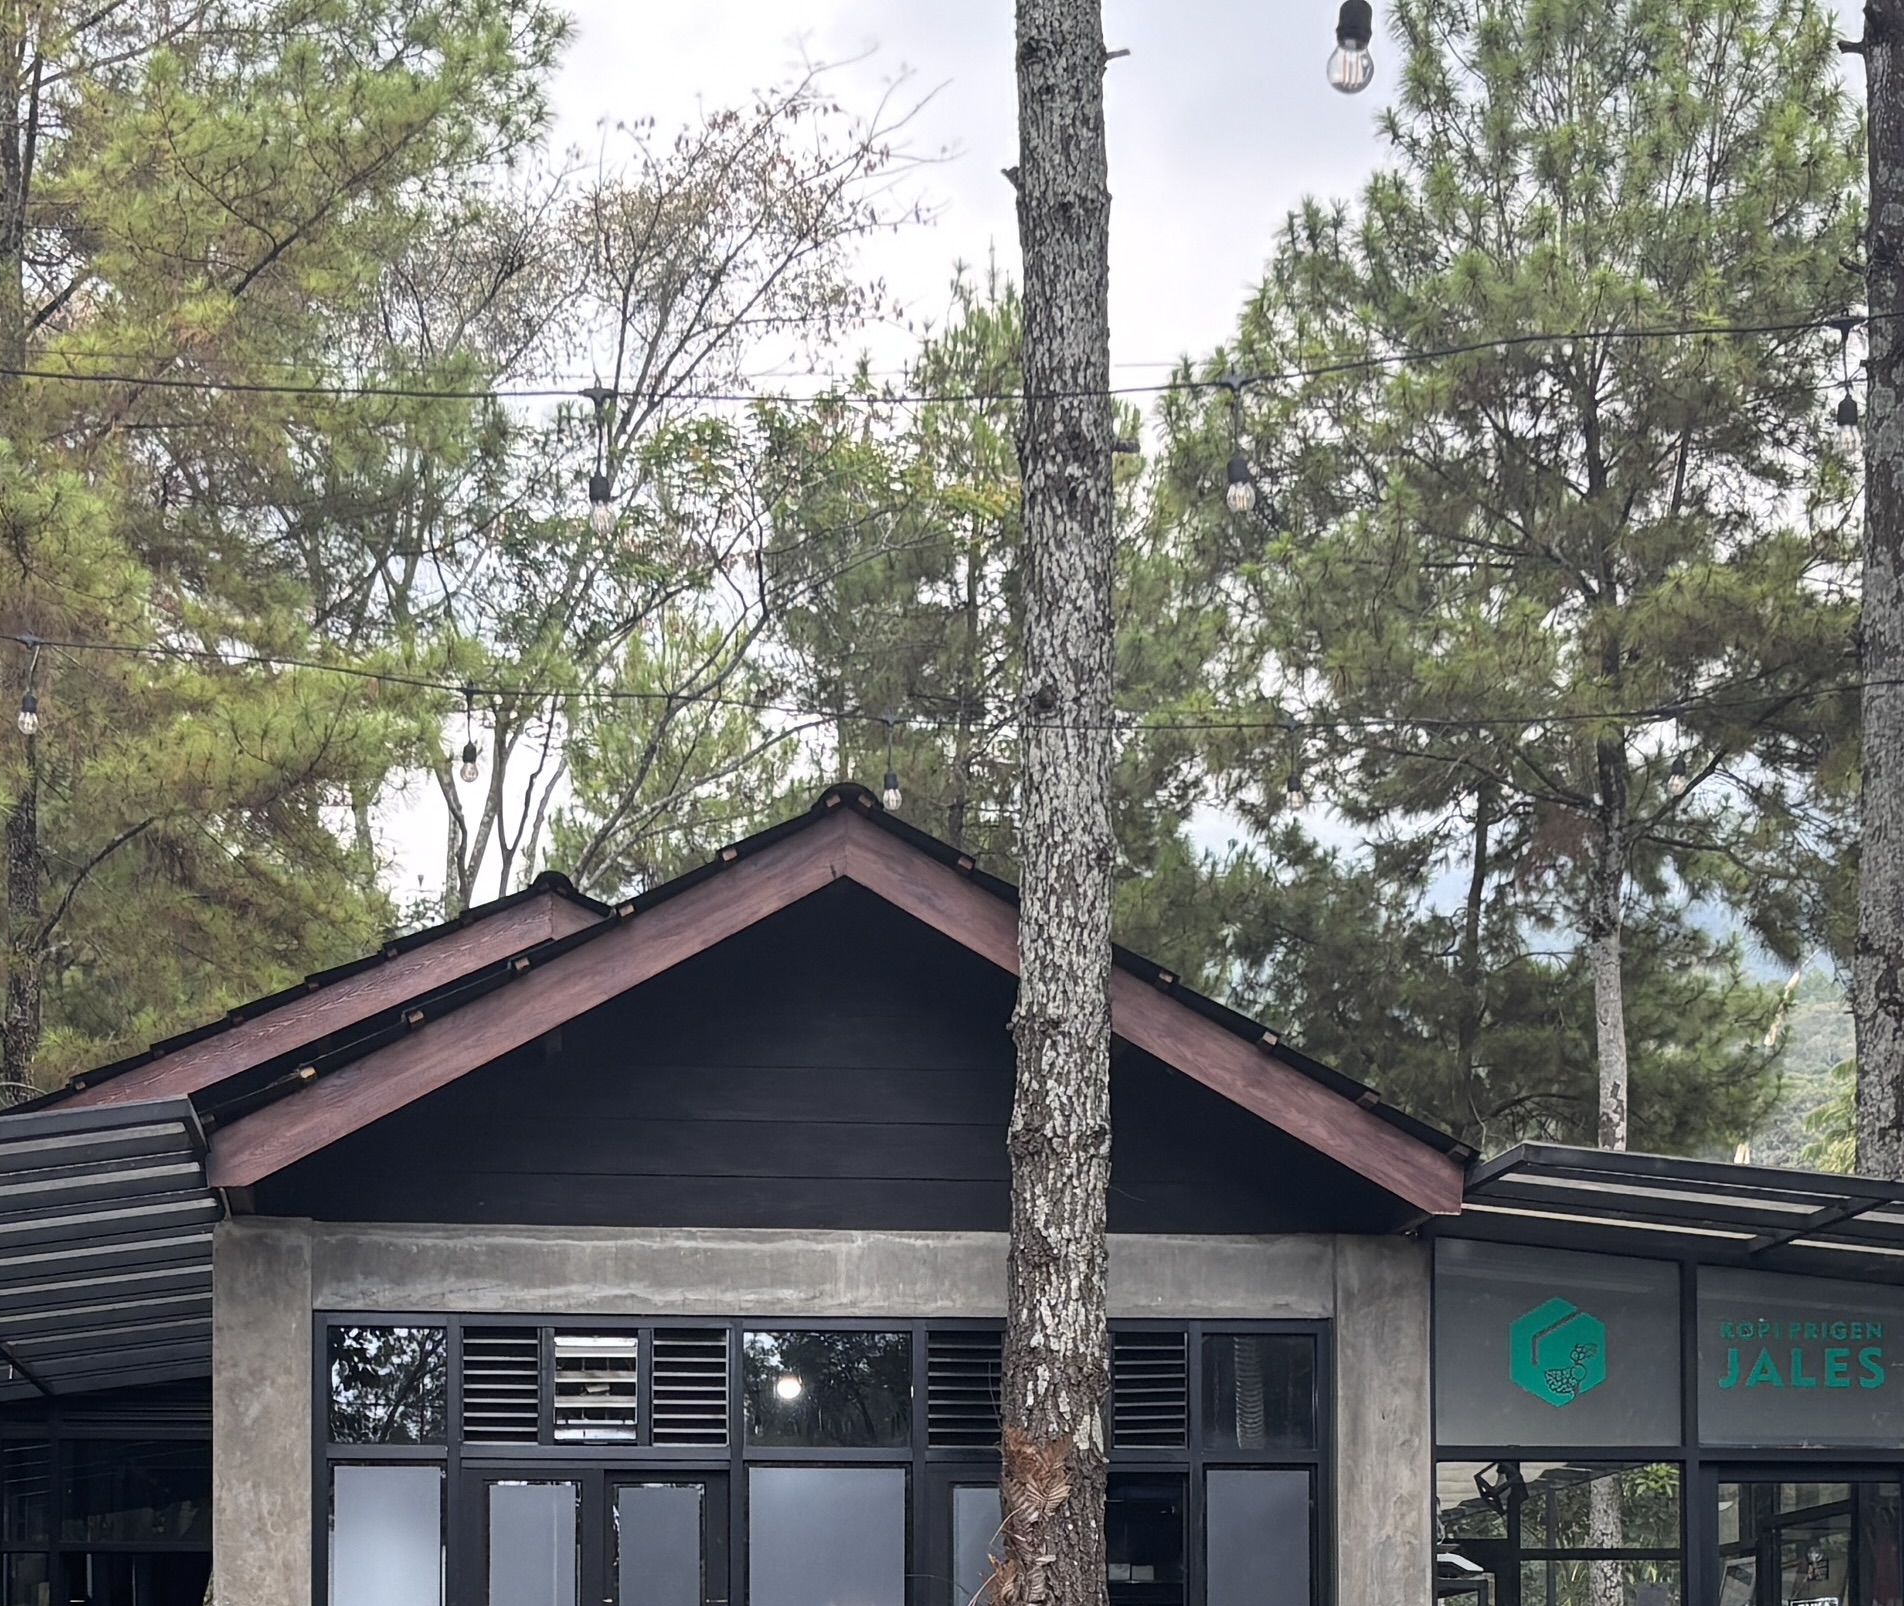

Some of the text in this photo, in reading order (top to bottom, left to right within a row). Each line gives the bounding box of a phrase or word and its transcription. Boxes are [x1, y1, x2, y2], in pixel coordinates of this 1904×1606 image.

[1720, 1321, 1884, 1340] KOPI PRIGEN
[1718, 1347, 1886, 1389] JALES
